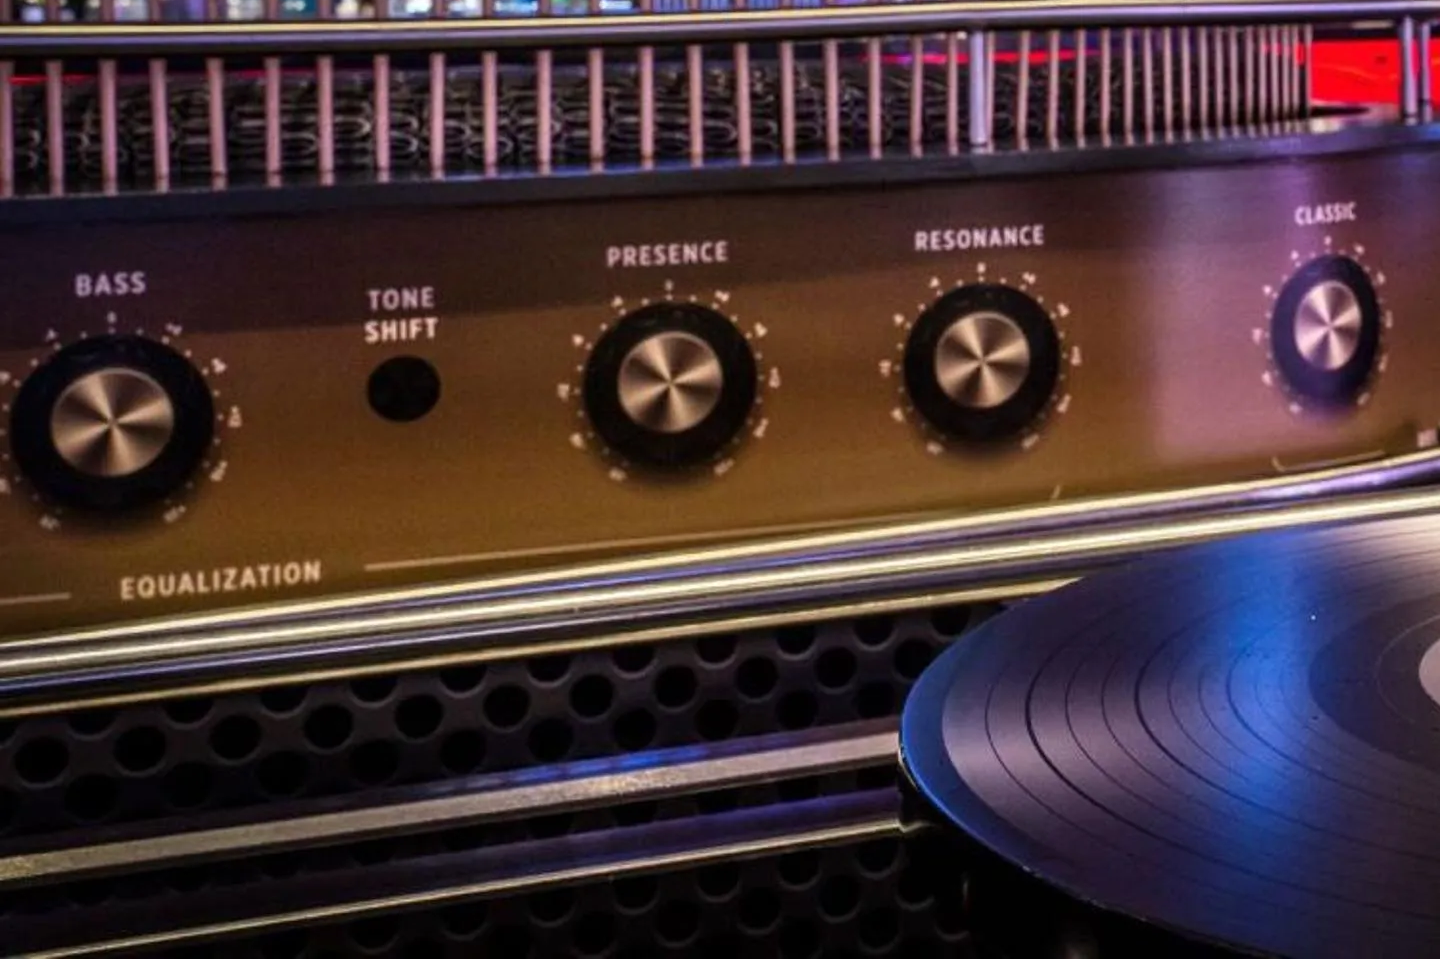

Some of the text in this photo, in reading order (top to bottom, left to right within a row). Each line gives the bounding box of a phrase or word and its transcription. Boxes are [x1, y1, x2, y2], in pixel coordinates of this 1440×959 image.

[1294, 201, 1357, 226] CLASSIC
[914, 224, 1045, 252] RESONANCE
[606, 240, 729, 268] PRESENCE
[74, 271, 147, 298] BASS
[367, 286, 436, 311] TONE
[364, 316, 439, 344] SHIFT
[119, 560, 323, 601] EQUALIZATION
